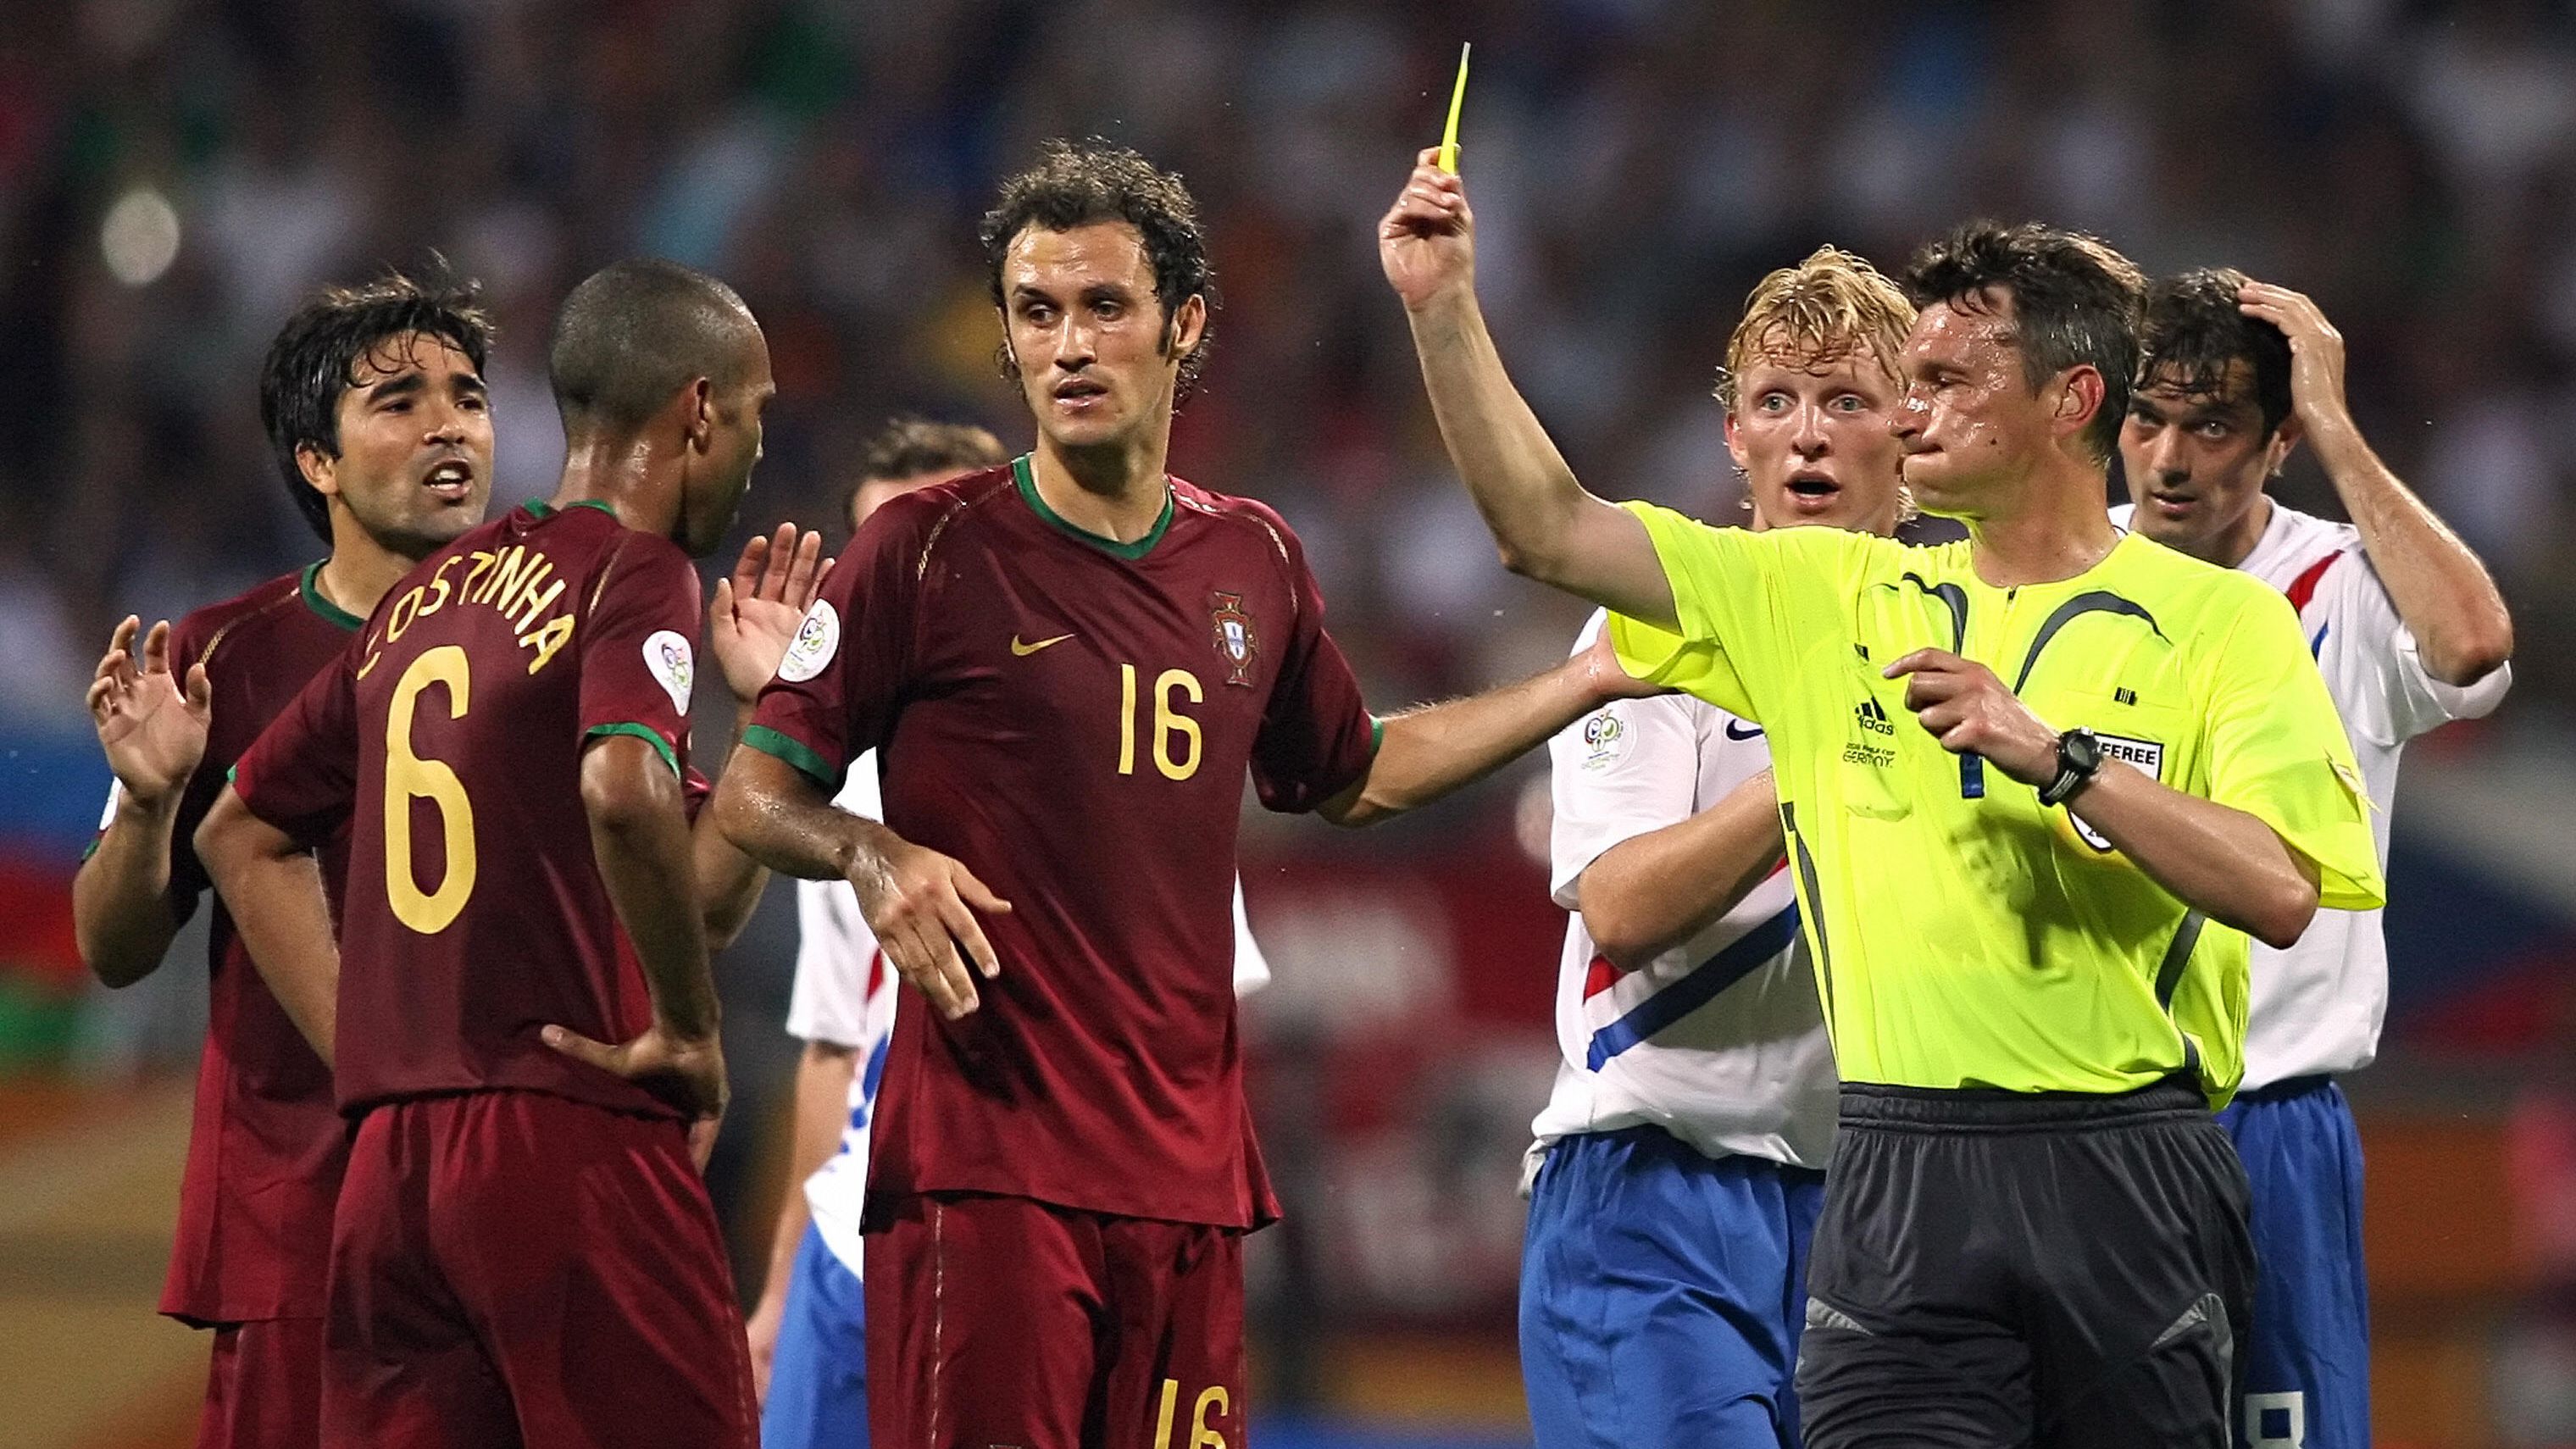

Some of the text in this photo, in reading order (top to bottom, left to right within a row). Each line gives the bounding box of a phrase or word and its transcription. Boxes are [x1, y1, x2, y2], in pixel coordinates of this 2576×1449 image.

[1118, 663, 1203, 781] 16
[2101, 742, 2157, 765] FEREE
[384, 645, 477, 935] 6
